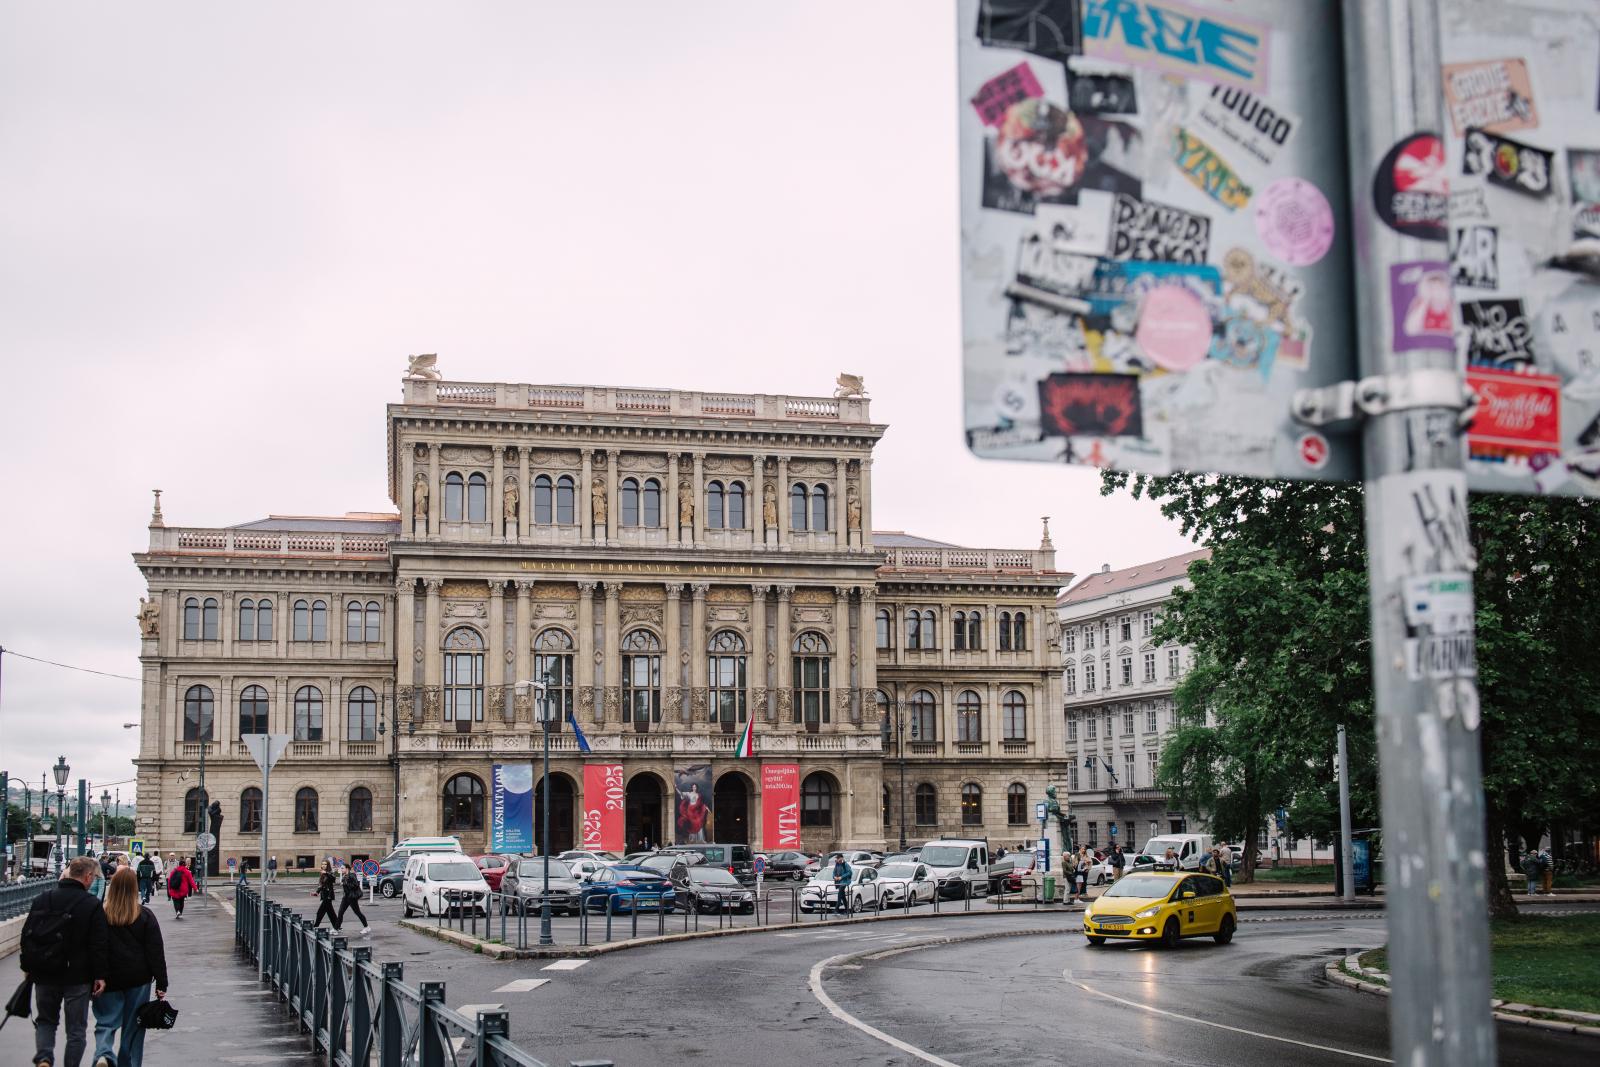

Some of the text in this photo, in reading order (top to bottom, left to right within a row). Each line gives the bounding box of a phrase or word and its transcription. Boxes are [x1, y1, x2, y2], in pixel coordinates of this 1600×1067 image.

[521, 561, 575, 570] MAGYAR
[693, 565, 763, 575] AKADÉMIA
[605, 765, 623, 810] 2025
[583, 809, 602, 850] 1825
[778, 801, 798, 846] MTA
